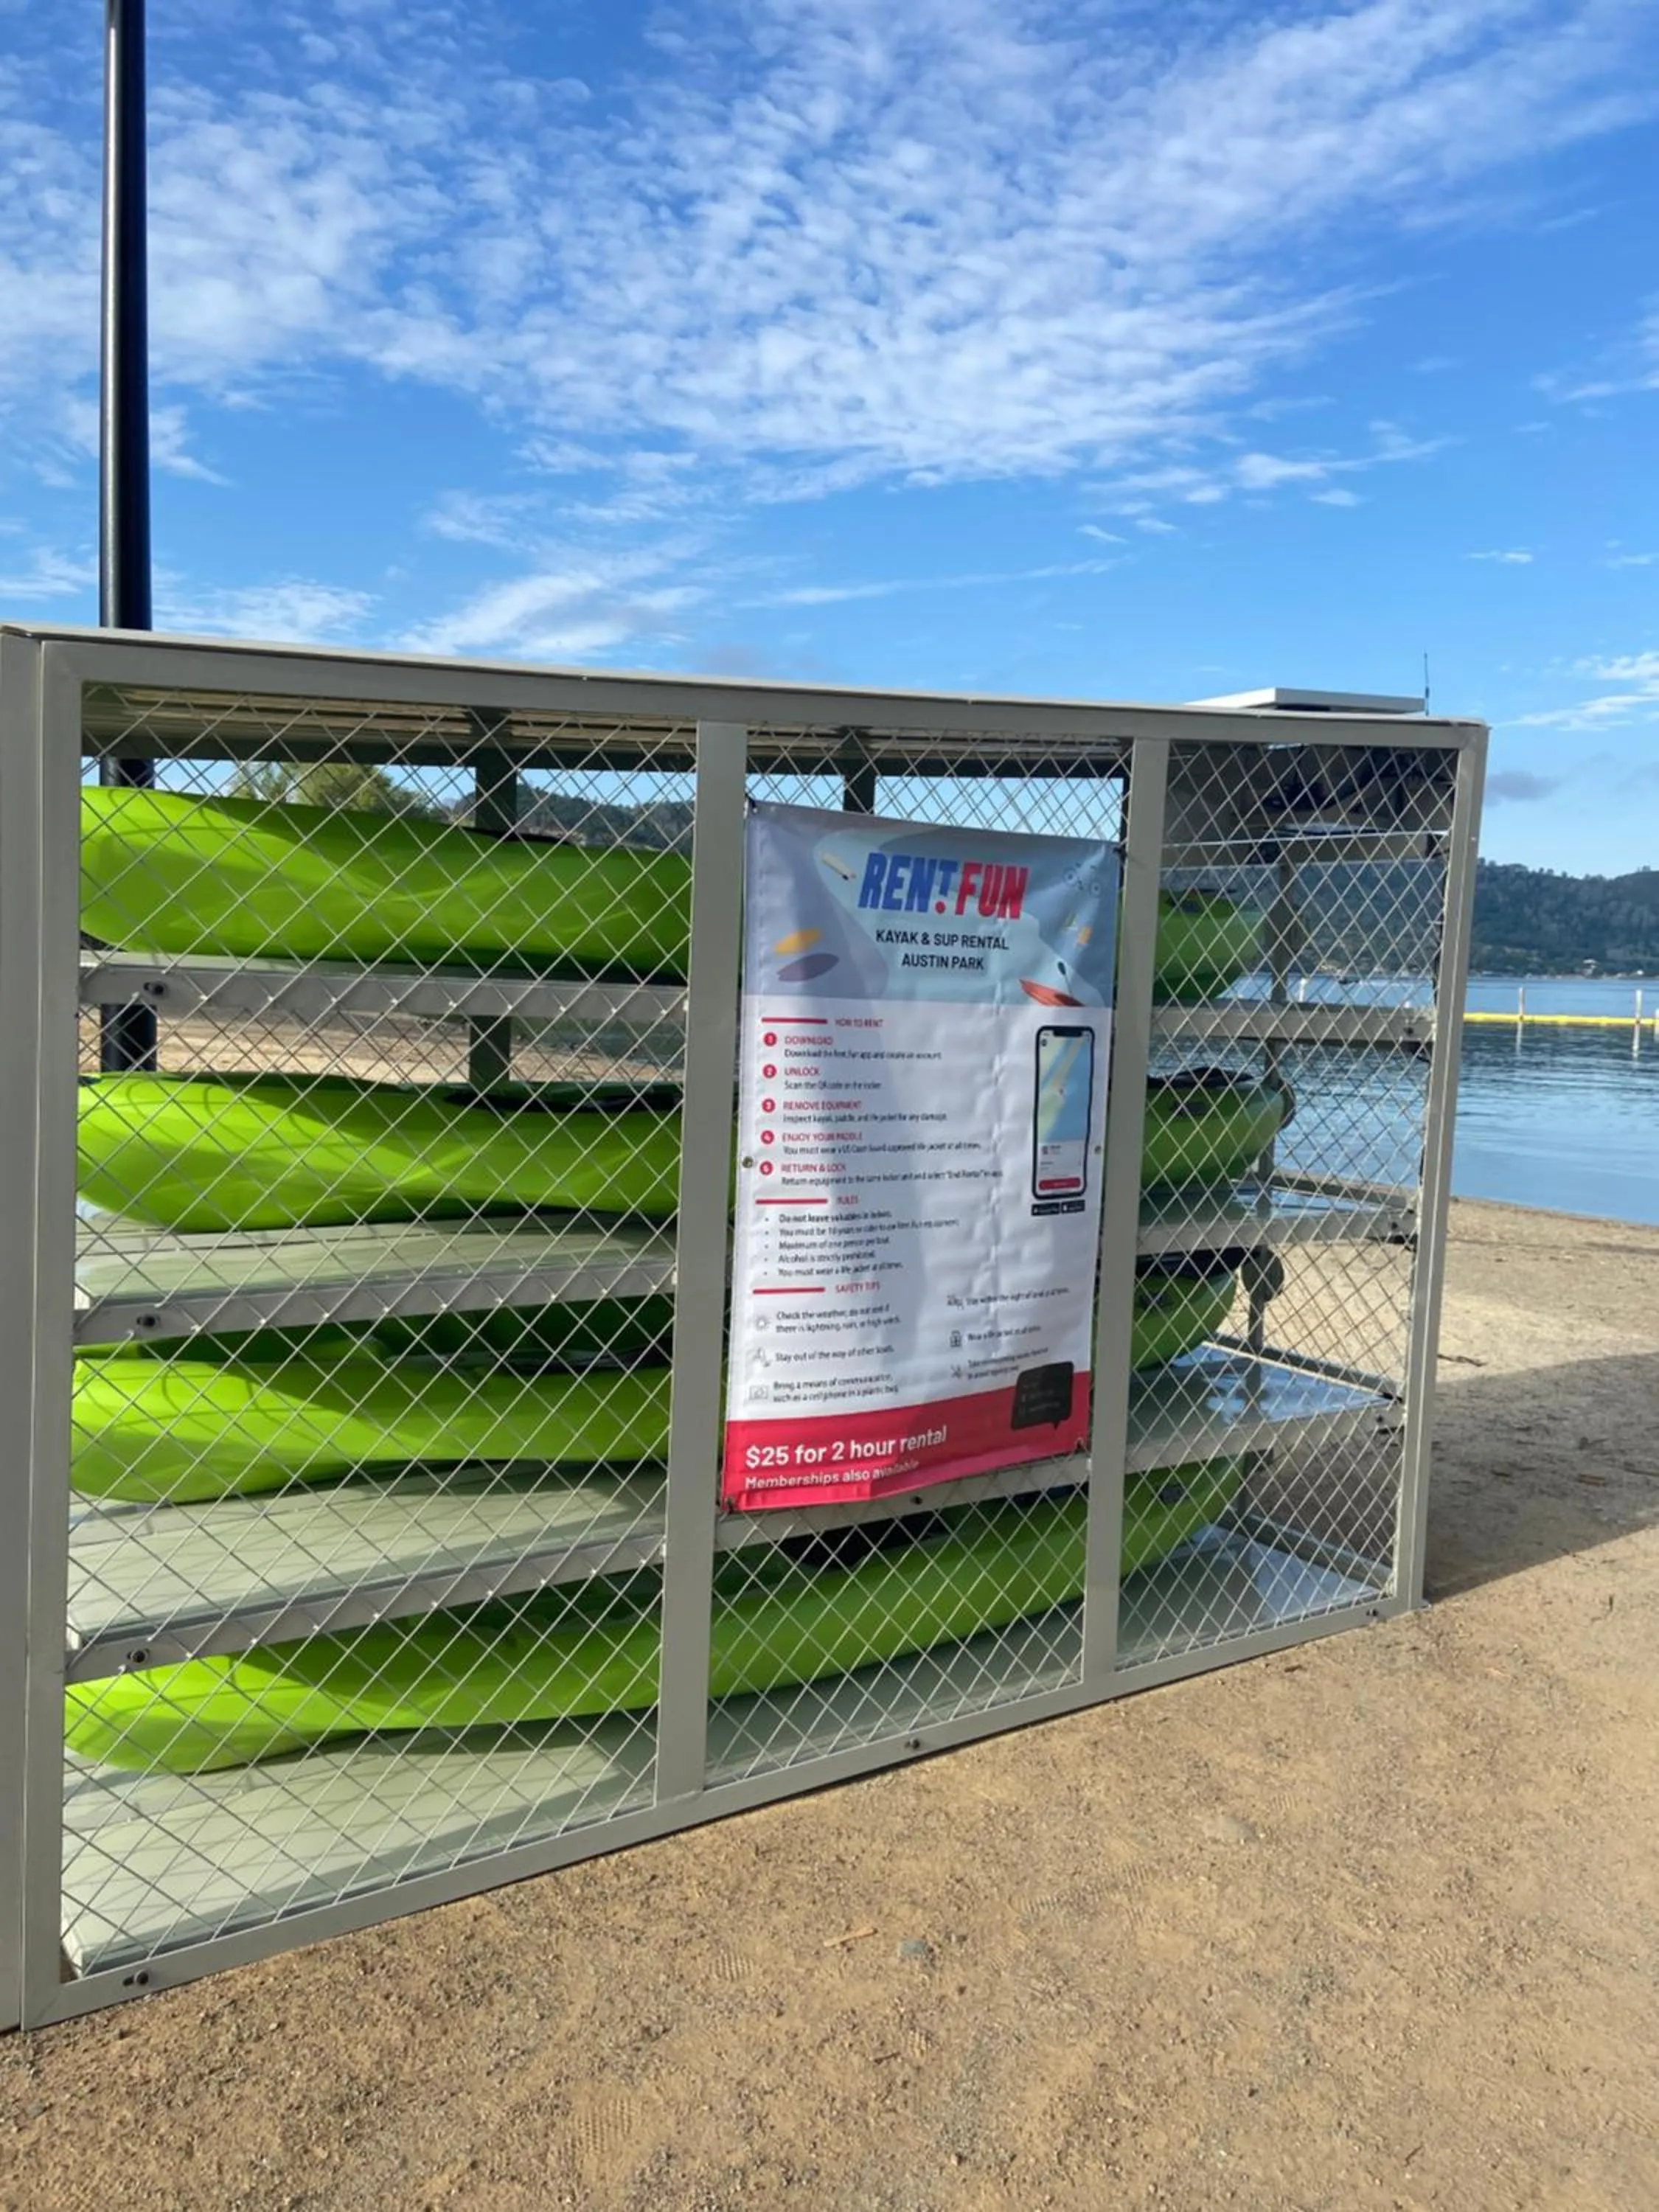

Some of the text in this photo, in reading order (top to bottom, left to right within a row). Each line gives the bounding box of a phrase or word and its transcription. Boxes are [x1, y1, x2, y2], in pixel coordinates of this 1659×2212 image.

[876, 929, 1009, 950] KAYAK & SUP RENTAL
[902, 953, 984, 970] AUSTIN PARK
[853, 1019, 863, 1027] TO
[864, 1019, 883, 1028] RENT
[785, 1036, 833, 1046] DOWNLOAD
[785, 1068, 820, 1076] UNLOCK
[785, 1079, 803, 1089] Scan
[783, 1101, 820, 1110] REMOVE
[783, 1114, 811, 1123] Inspect
[782, 1132, 810, 1141] ENJOY
[813, 1133, 835, 1141] YOUR
[836, 1132, 862, 1141] PADDLE
[784, 1146, 798, 1155] You
[782, 1164, 818, 1172] RETURN
[818, 1163, 825, 1172] &
[827, 1163, 846, 1172] LOCK
[837, 1195, 859, 1205] RULES
[779, 1214, 789, 1222] Do
[791, 1214, 807, 1222] not
[808, 1213, 829, 1222] leave
[795, 1228, 814, 1236] must
[816, 1227, 826, 1235] be
[779, 1242, 816, 1250] Maximum
[778, 1254, 808, 1263] Alcohol
[817, 1253, 841, 1262] strictly
[835, 1281, 880, 1293] SAFETY TIPS
[776, 1310, 800, 1321] Check
[802, 1310, 814, 1320] the
[776, 1324, 796, 1333] there
[776, 1352, 791, 1363] Stay
[793, 1352, 807, 1361] out
[818, 1350, 830, 1359] the
[832, 1351, 846, 1359] way
[848, 1348, 855, 1357] of
[802, 1380, 827, 1389] means
[829, 1378, 837, 1387] of
[746, 1425, 947, 1469] $25 for 2 hour rental
[745, 1472, 839, 1489] Memberships
[843, 1470, 870, 1481] also
